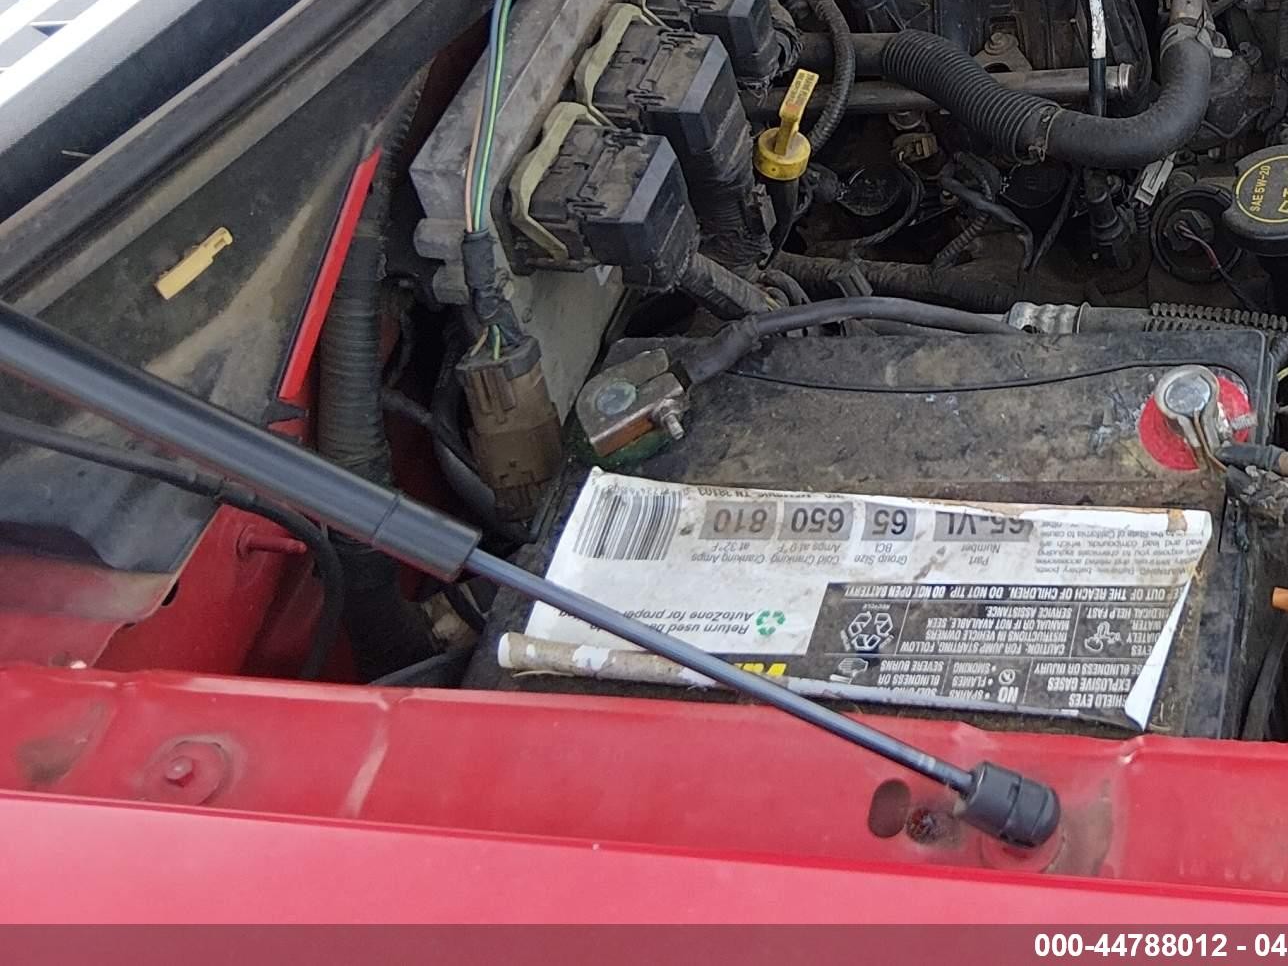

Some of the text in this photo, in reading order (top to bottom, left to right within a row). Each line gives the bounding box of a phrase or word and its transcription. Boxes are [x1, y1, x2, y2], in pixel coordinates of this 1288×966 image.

[1250, 165, 1271, 211] SAE 5W-20
[714, 508, 768, 534] 810
[791, 508, 845, 534] 650
[872, 510, 908, 535] 65
[1077, 530, 1115, 538] California
[1117, 530, 1126, 538] of
[712, 542, 750, 552] at 32°F
[799, 544, 811, 552] at
[811, 544, 840, 554] Amps
[875, 543, 892, 553] BCI
[961, 544, 1000, 554] Number
[691, 554, 766, 564] Cranking Amps
[770, 554, 841, 565] Cold Cranking
[854, 553, 908, 565] Group Size
[969, 555, 989, 565] Part
[844, 585, 888, 597] BATTERY!
[888, 586, 912, 598] OPEN
[913, 586, 931, 598] NOT
[931, 586, 946, 598] DO
[950, 586, 966, 598] TIP.
[969, 586, 988, 599] NOT
[988, 586, 1004, 599] DO
[1008, 587, 1060, 601] CHILDREN.
[1060, 588, 1073, 600] OF
[1074, 588, 1107, 601] REACH
[1108, 588, 1128, 601] THE
[1130, 588, 1144, 601] OF
[1144, 588, 1166, 601] OUT
[669, 611, 687, 621] for
[690, 611, 754, 622] AutoZone
[985, 606, 1072, 619] SERVICE ASSISTANCE.
[1085, 607, 1108, 619] FAST.
[1110, 607, 1131, 619] HELP
[668, 624, 700, 635] used
[704, 624, 750, 635] Return
[925, 617, 1070, 630] MANUAL OR IF NOT AVAILABLE, SEEK
[925, 629, 1067, 642] INSTRUCTIONS IN VEHICLE OWNERS
[899, 641, 936, 653] FOLLOW
[980, 642, 1004, 654] JUMP
[1004, 643, 1022, 654] FOR
[1025, 643, 1065, 654] CAUTION:
[1131, 645, 1152, 656] EYES
[879, 660, 944, 672] SEVERE BURNS
[953, 662, 990, 674] SMOKING
[1033, 662, 1067, 676] INJURY
[1068, 663, 1081, 676] OR
[1082, 663, 1130, 676] BLINDNESS
[877, 673, 940, 686] BLINDNESS OR
[951, 676, 987, 687] FLAMES
[1047, 677, 1132, 693] EXPLOSIVE GASES
[949, 689, 984, 700] SPARKS
[997, 686, 1019, 704] NO
[1069, 693, 1093, 708] EYES
